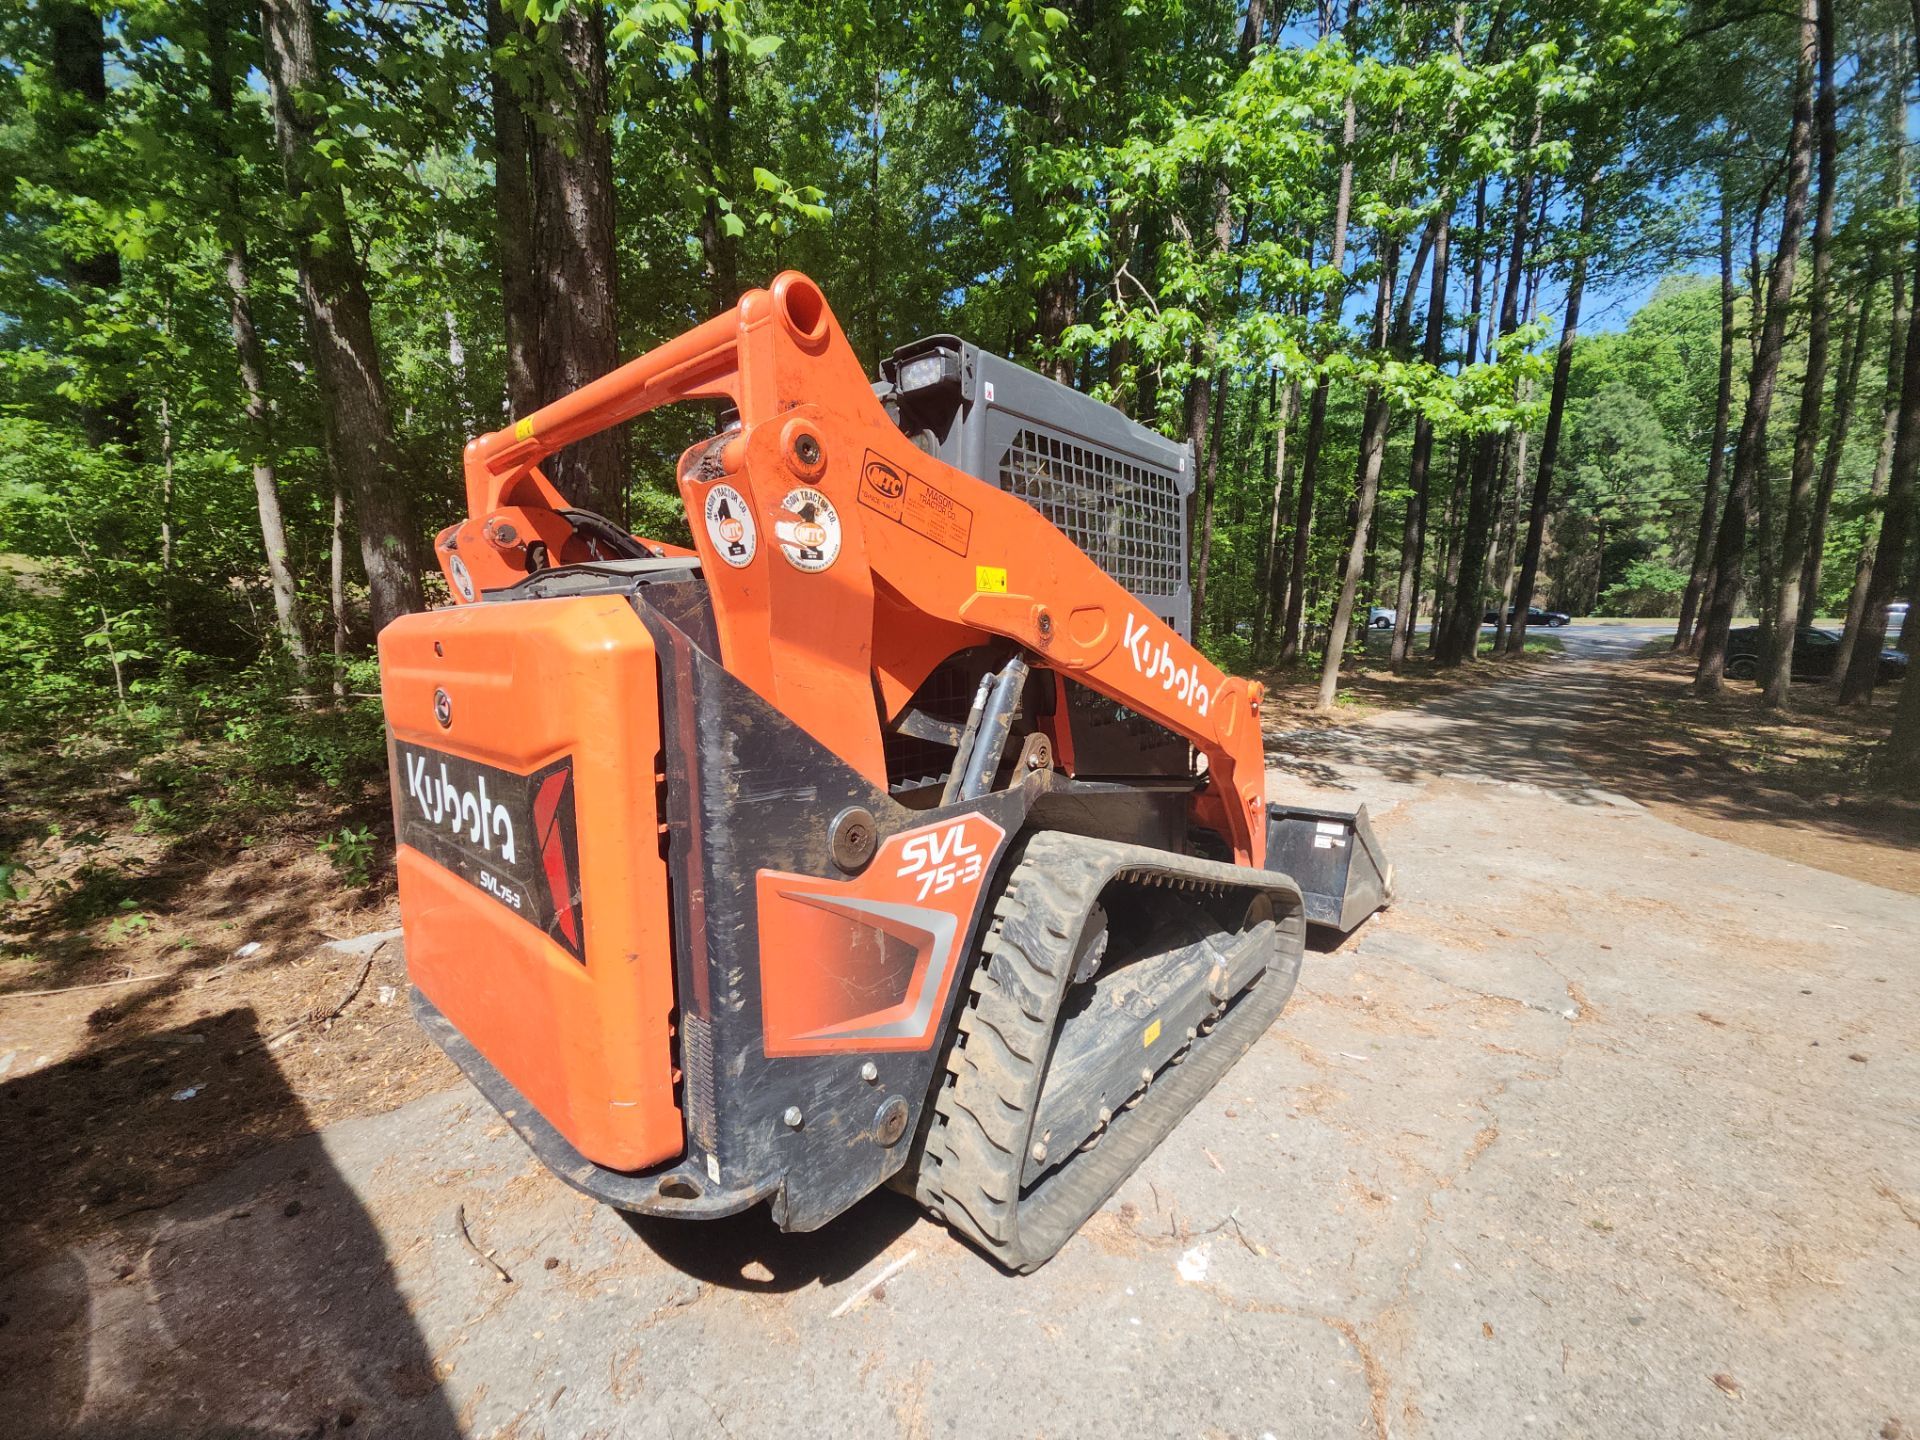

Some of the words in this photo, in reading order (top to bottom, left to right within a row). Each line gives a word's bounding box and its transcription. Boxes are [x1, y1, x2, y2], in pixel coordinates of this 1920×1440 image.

[800, 490, 829, 512] TRACTOR
[919, 493, 947, 516] TRACTOR
[926, 487, 954, 511] MASON
[1123, 612, 1209, 717] Kubota
[406, 752, 516, 865] Kubota
[896, 824, 977, 878] SVL
[916, 854, 982, 902] 75-3
